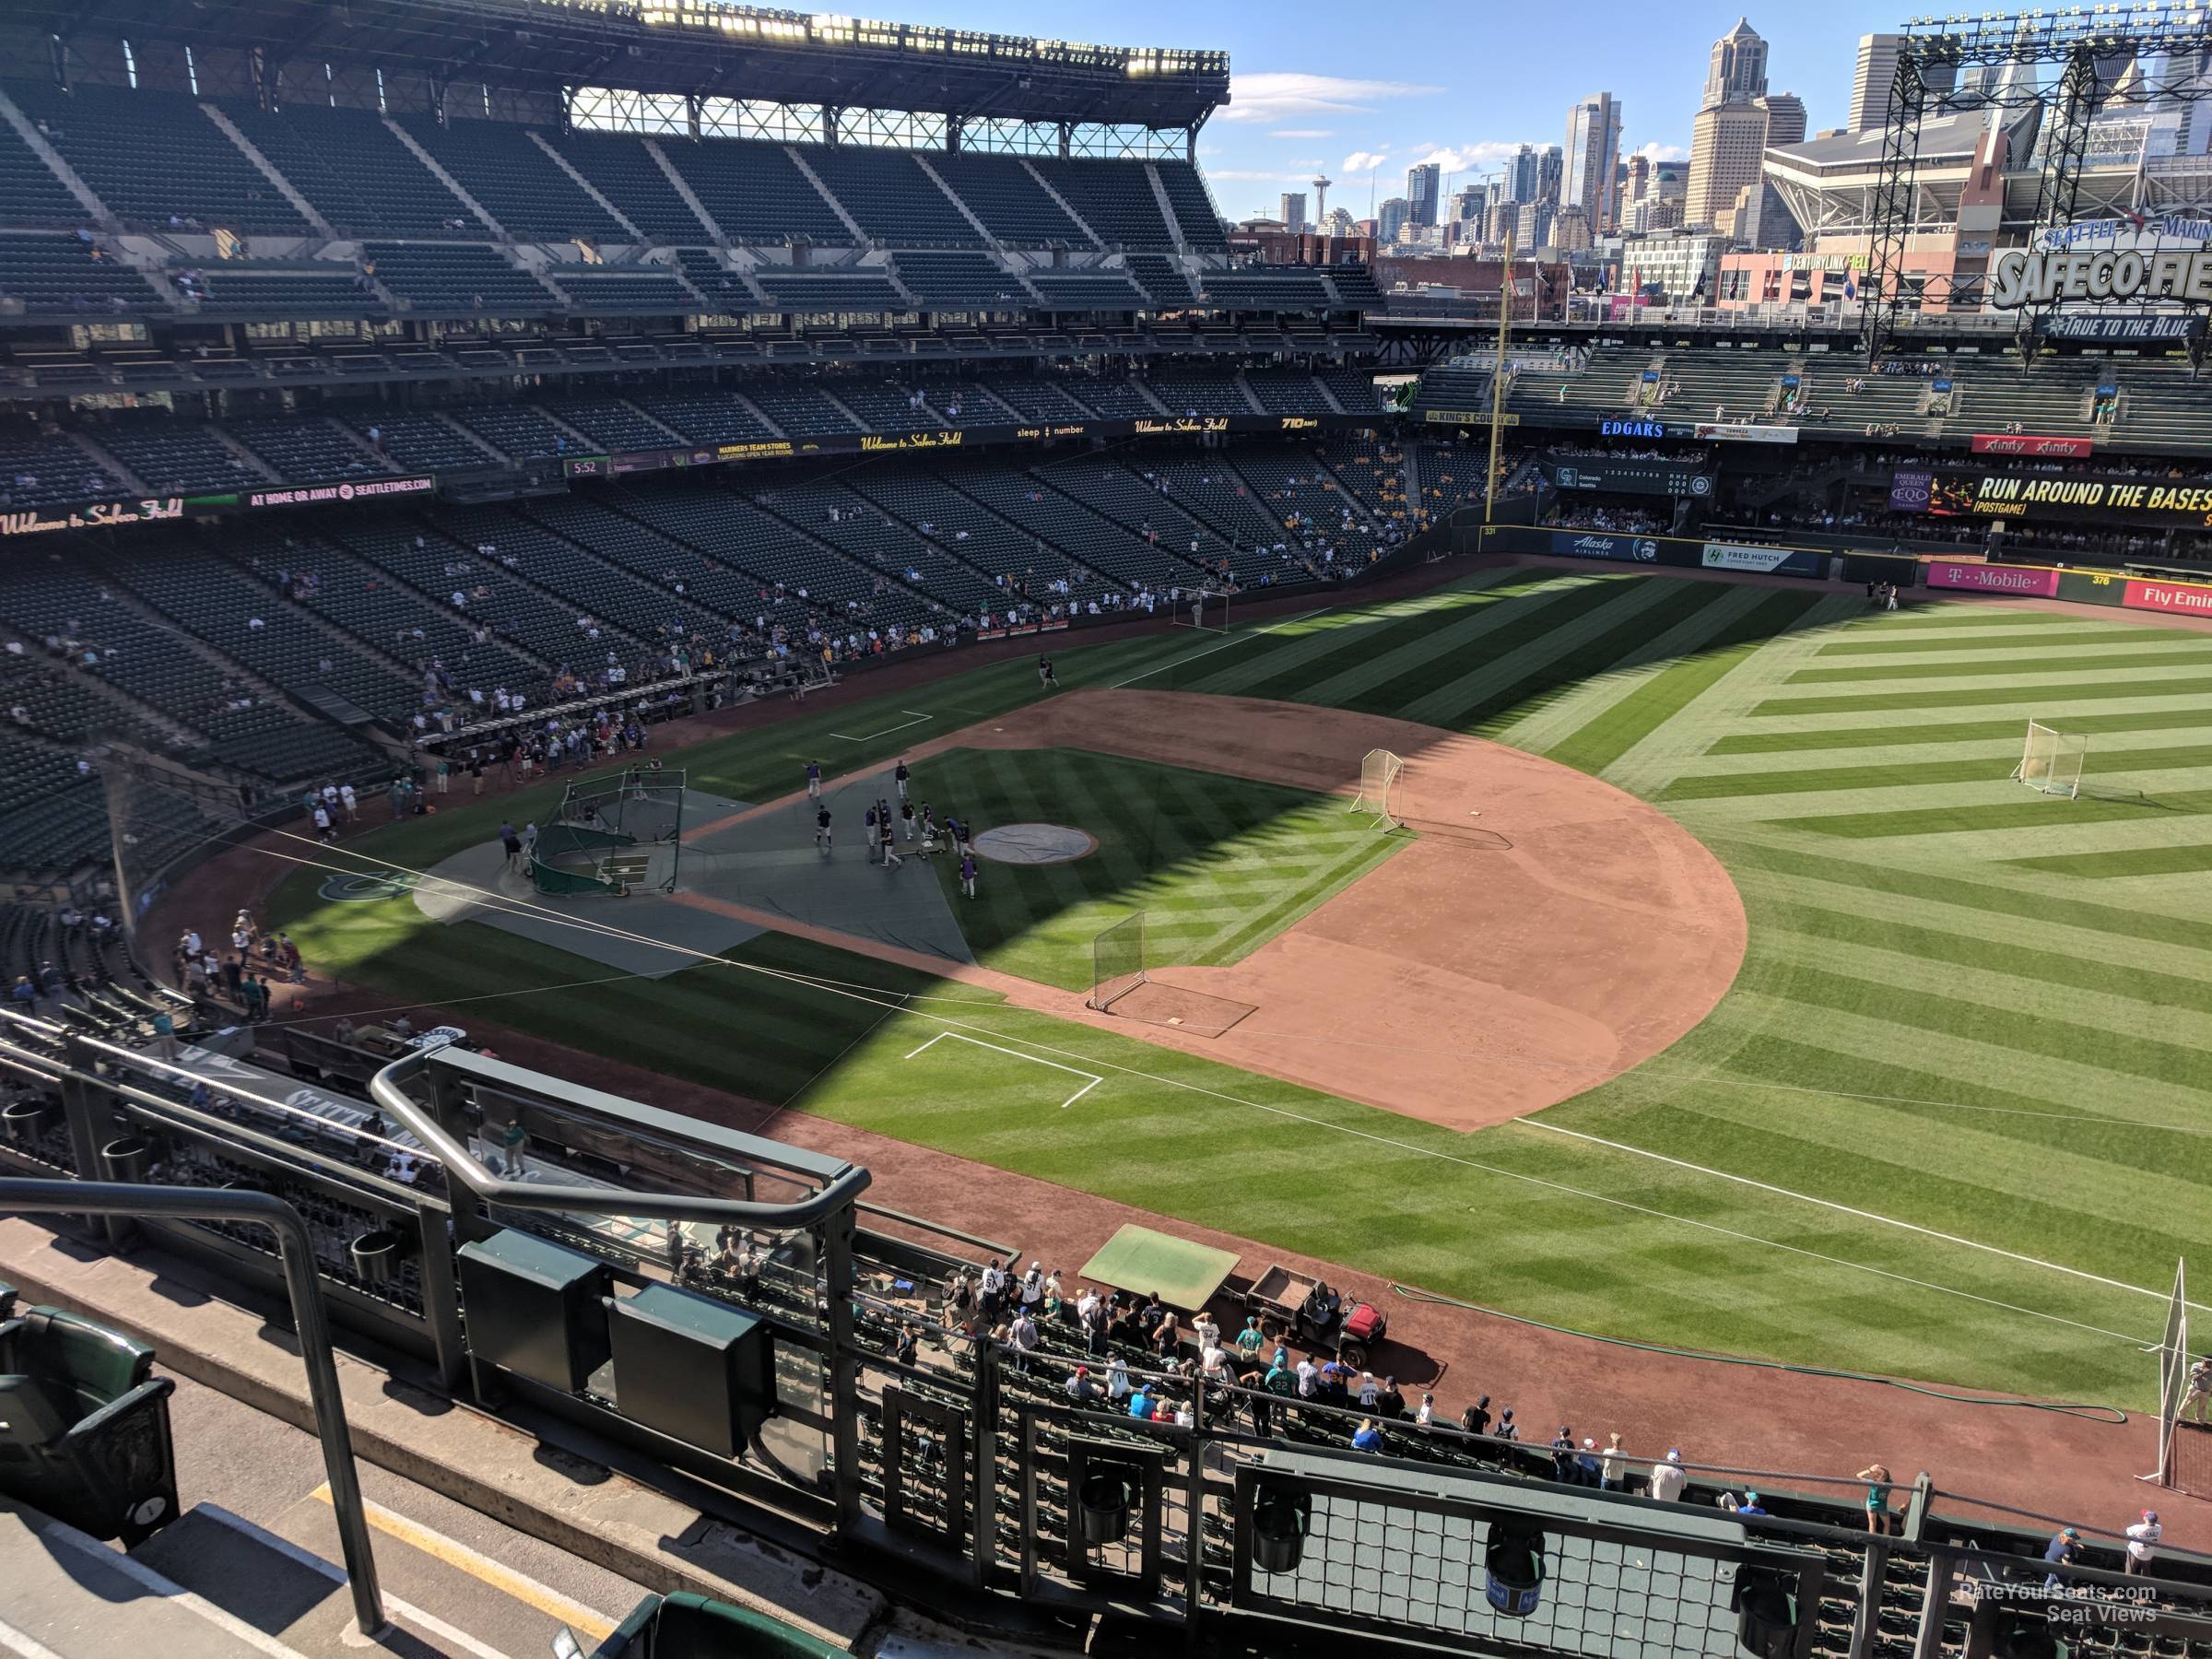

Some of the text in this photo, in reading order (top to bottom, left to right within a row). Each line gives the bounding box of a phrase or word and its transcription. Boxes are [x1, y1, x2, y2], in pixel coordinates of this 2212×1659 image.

[2041, 220, 2118, 249] SEATTLE
[1792, 253, 1871, 270] CENTURYLINK FIELD
[1992, 251, 2146, 310] SAFECO
[2064, 315, 2193, 337] TRUE TO THE BLUE
[1282, 418, 1304, 429] 710
[1439, 412, 1471, 422] KING'S
[1017, 426, 1083, 439] sleep number
[1135, 418, 1229, 433] Welcome to Safeco Field
[719, 442, 791, 454] MARINERS TEAM STORES
[861, 431, 962, 451] Welcome to Safeco Field
[1984, 439, 2077, 455] xfinity xfinity
[574, 462, 596, 474] 5:52
[1579, 474, 1602, 482] Colorado
[1894, 472, 1932, 481] EMERALD
[251, 478, 431, 507] AT HOME OR AWAY SEATTLETIMES.COM
[1978, 477, 2212, 512] RUN AROUND THE BASES
[1972, 500, 2027, 516] (POSTGAME)
[0, 498, 183, 535] Welcome to Safeco Field
[1485, 527, 1496, 535] 331
[1572, 535, 1614, 550] Alaska
[1728, 551, 1780, 562] FRED HUTCH
[2092, 575, 2110, 586] 376
[2144, 588, 2172, 606] Fly
[1275, 1381, 1288, 1391] 22
